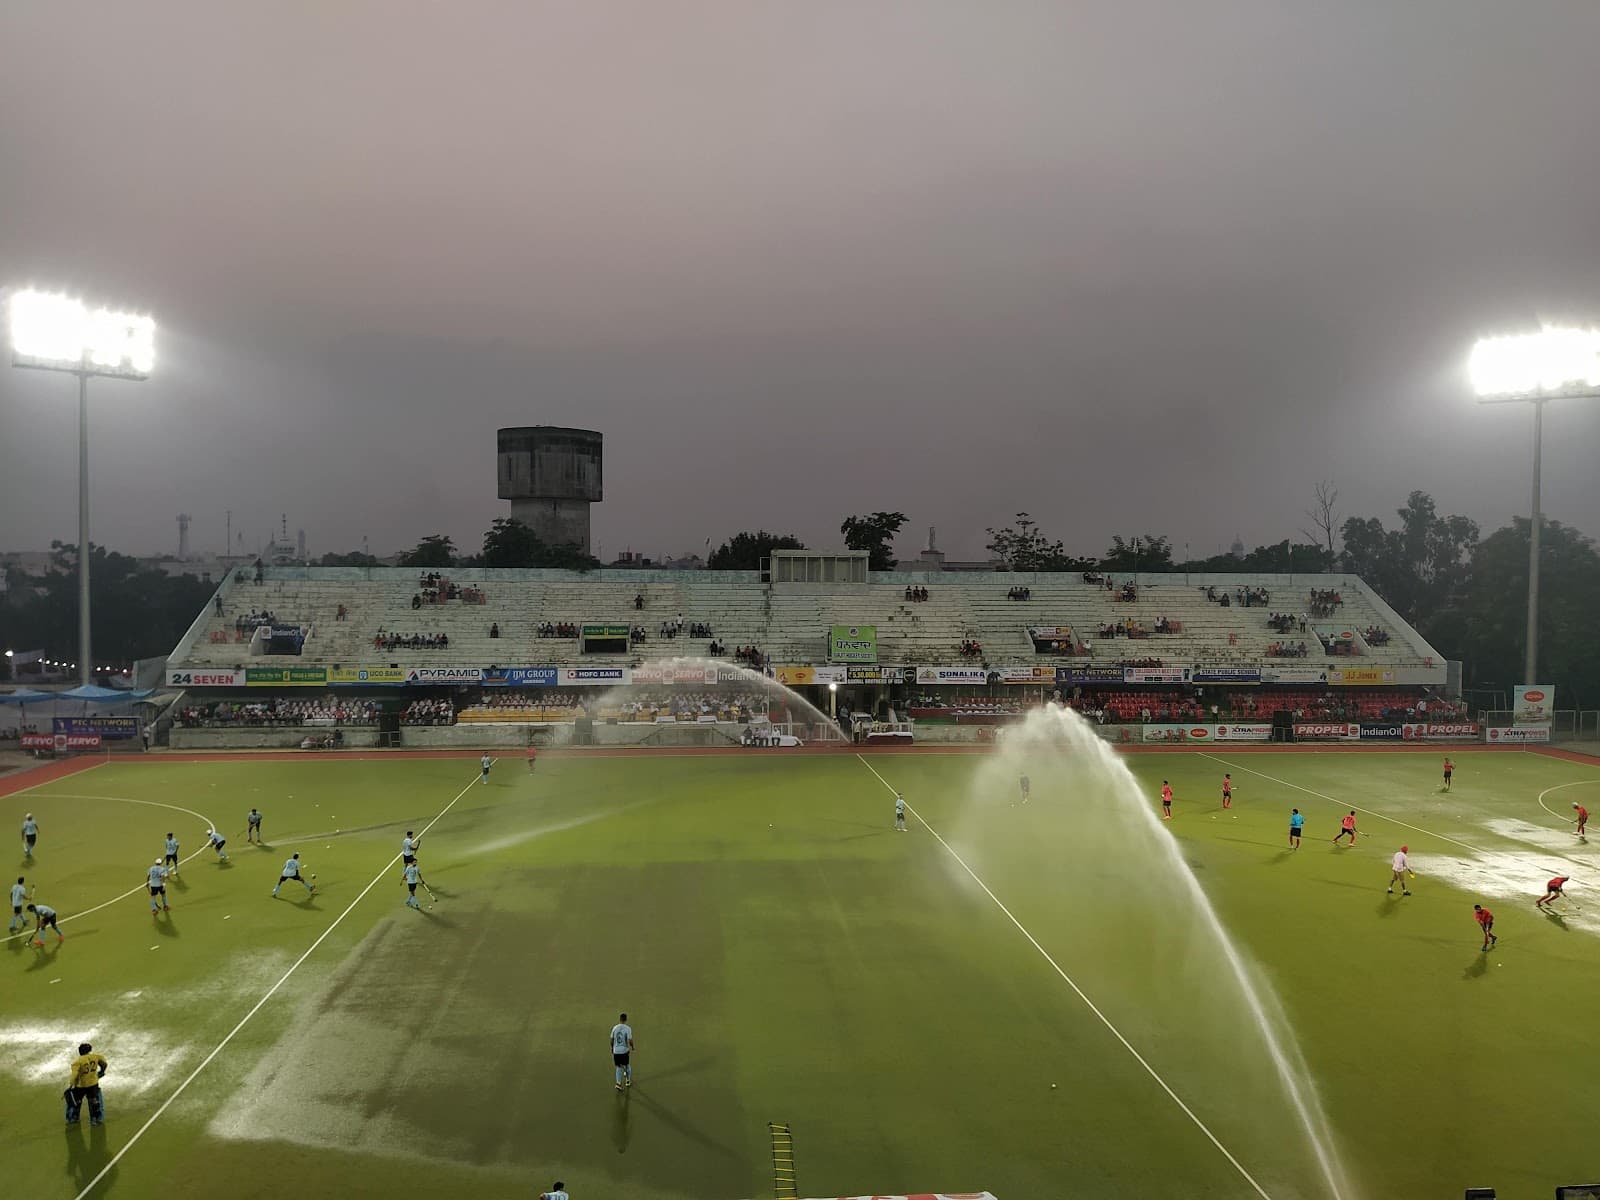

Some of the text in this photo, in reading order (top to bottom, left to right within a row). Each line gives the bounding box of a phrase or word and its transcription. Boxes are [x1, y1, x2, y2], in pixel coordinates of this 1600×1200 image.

[421, 669, 480, 677] PYRAMID
[526, 670, 556, 678] GROUP
[578, 670, 621, 678] HDFC BANK
[674, 670, 704, 679] SERVO
[939, 671, 985, 679] SONALIKA
[172, 673, 192, 685] 24
[193, 674, 234, 685] SEVEN
[1297, 726, 1346, 734] PROPEL
[1361, 727, 1402, 736] IndianOil
[1429, 725, 1476, 733] PROPEL
[22, 737, 53, 745] SERVO
[67, 737, 99, 745] SERVO
